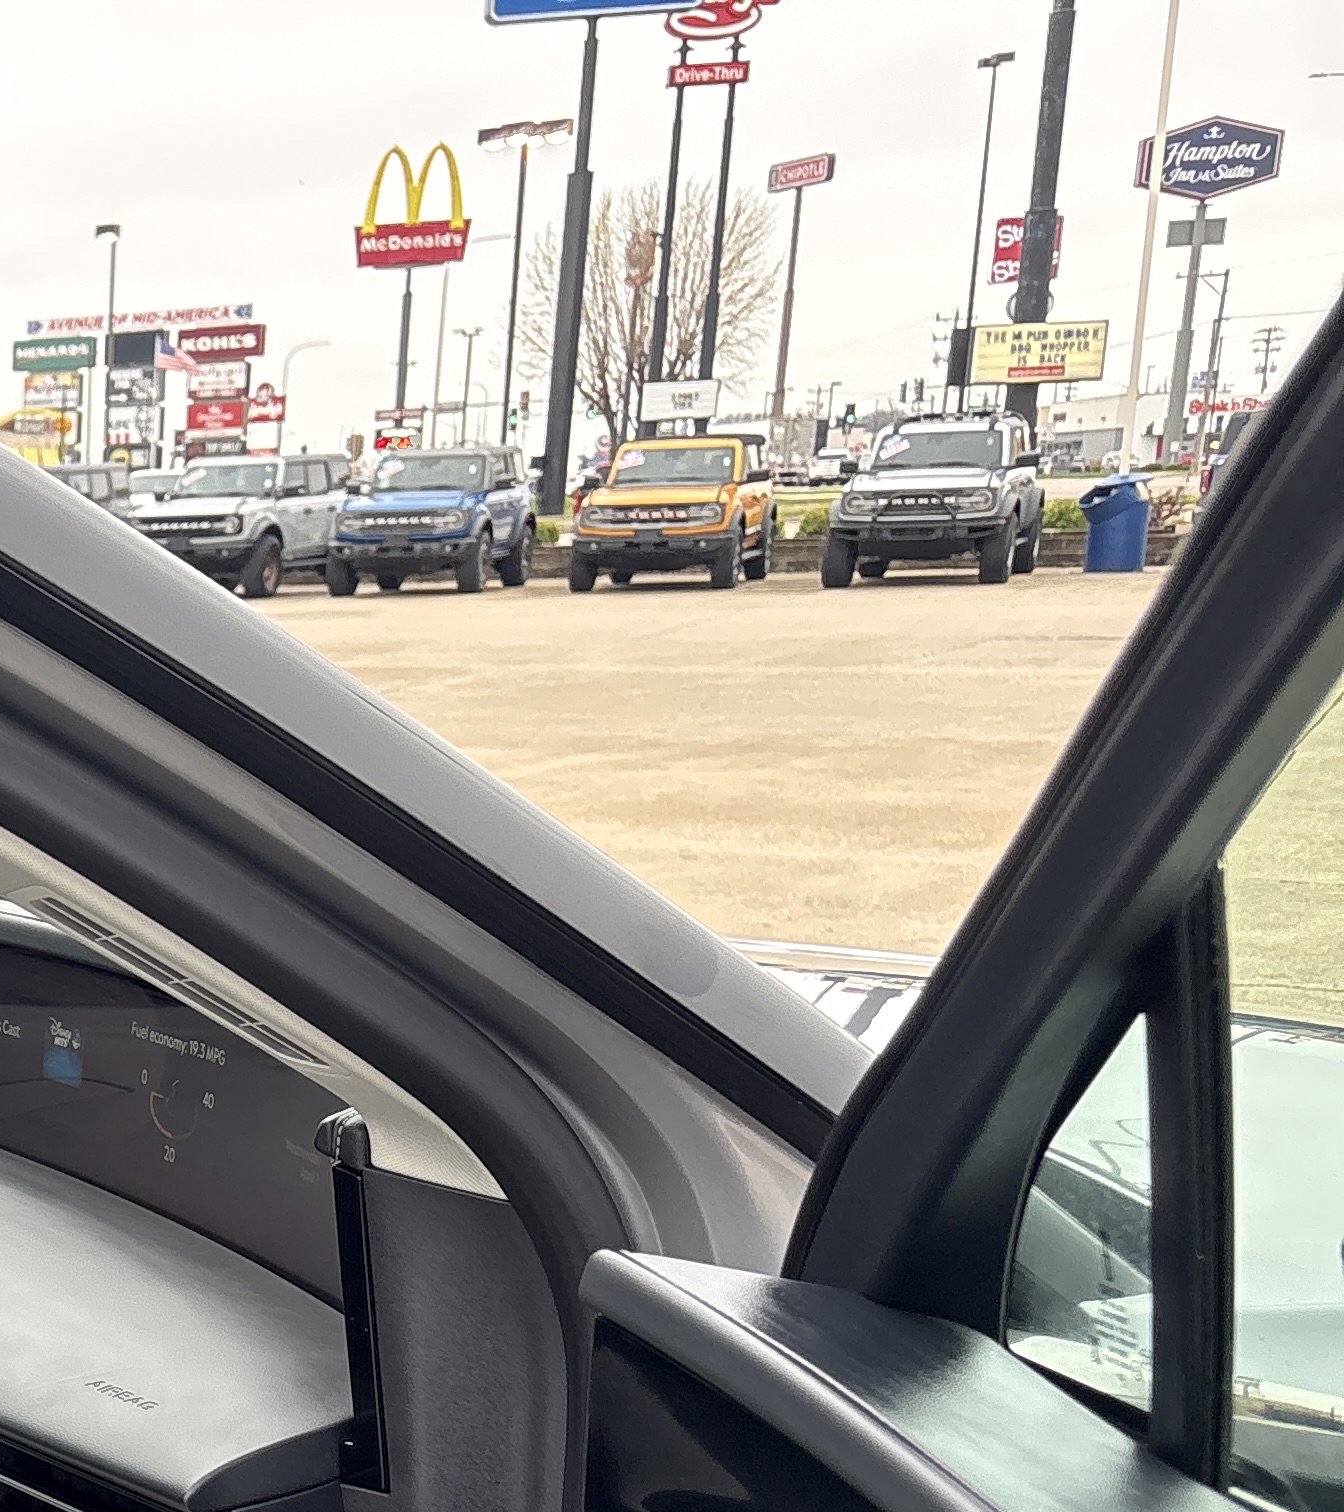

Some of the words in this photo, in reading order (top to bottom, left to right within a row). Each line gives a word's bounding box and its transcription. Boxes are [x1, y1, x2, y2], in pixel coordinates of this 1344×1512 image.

[674, 66, 744, 83] Drive-Thru
[1162, 140, 1272, 169] Hampton
[780, 160, 825, 183] CHIPOTLE
[1162, 167, 1198, 186] Inn
[1209, 163, 1256, 181] Suites
[359, 232, 464, 253] McDonald's
[47, 314, 104, 332] AVENUE
[179, 332, 257, 351] KOHL'S
[985, 330, 1007, 344] THE
[1040, 340, 1090, 353] WHOPPER
[15, 342, 90, 359] MENARDS
[1038, 353, 1067, 365] BACK
[2, 1019, 21, 1039] Cast
[131, 1020, 149, 1040] Fuel
[189, 1040, 206, 1059] 19.3
[205, 1044, 226, 1066] MPG
[140, 1068, 149, 1085] 0
[202, 1091, 215, 1109] 40
[163, 1144, 176, 1163] 20
[83, 1380, 160, 1411] AIRBAG
